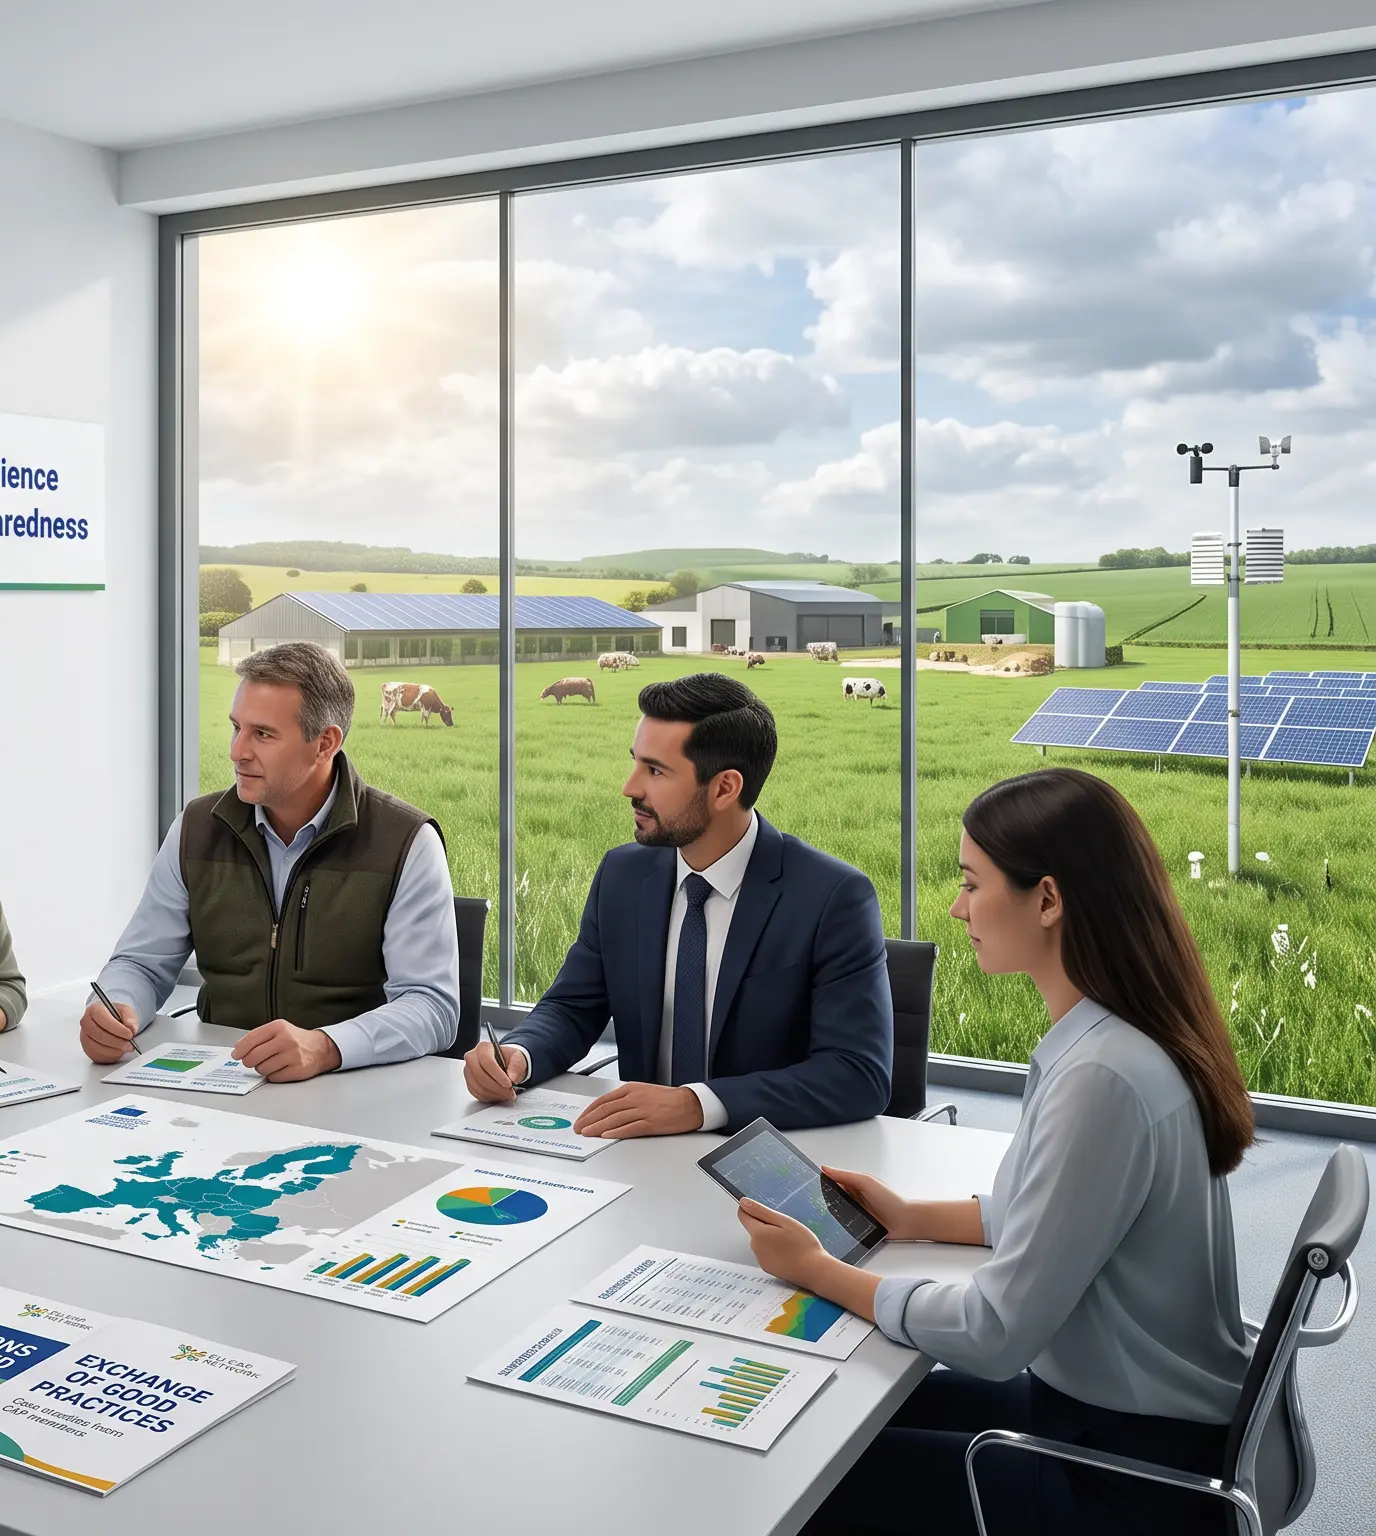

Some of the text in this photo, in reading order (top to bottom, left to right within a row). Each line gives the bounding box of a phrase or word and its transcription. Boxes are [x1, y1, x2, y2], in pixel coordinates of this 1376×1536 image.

[65, 1371, 178, 1413] OF GOOD
[75, 1354, 214, 1403] EXCHANGE
[29, 1380, 175, 1433] PRACTICES
